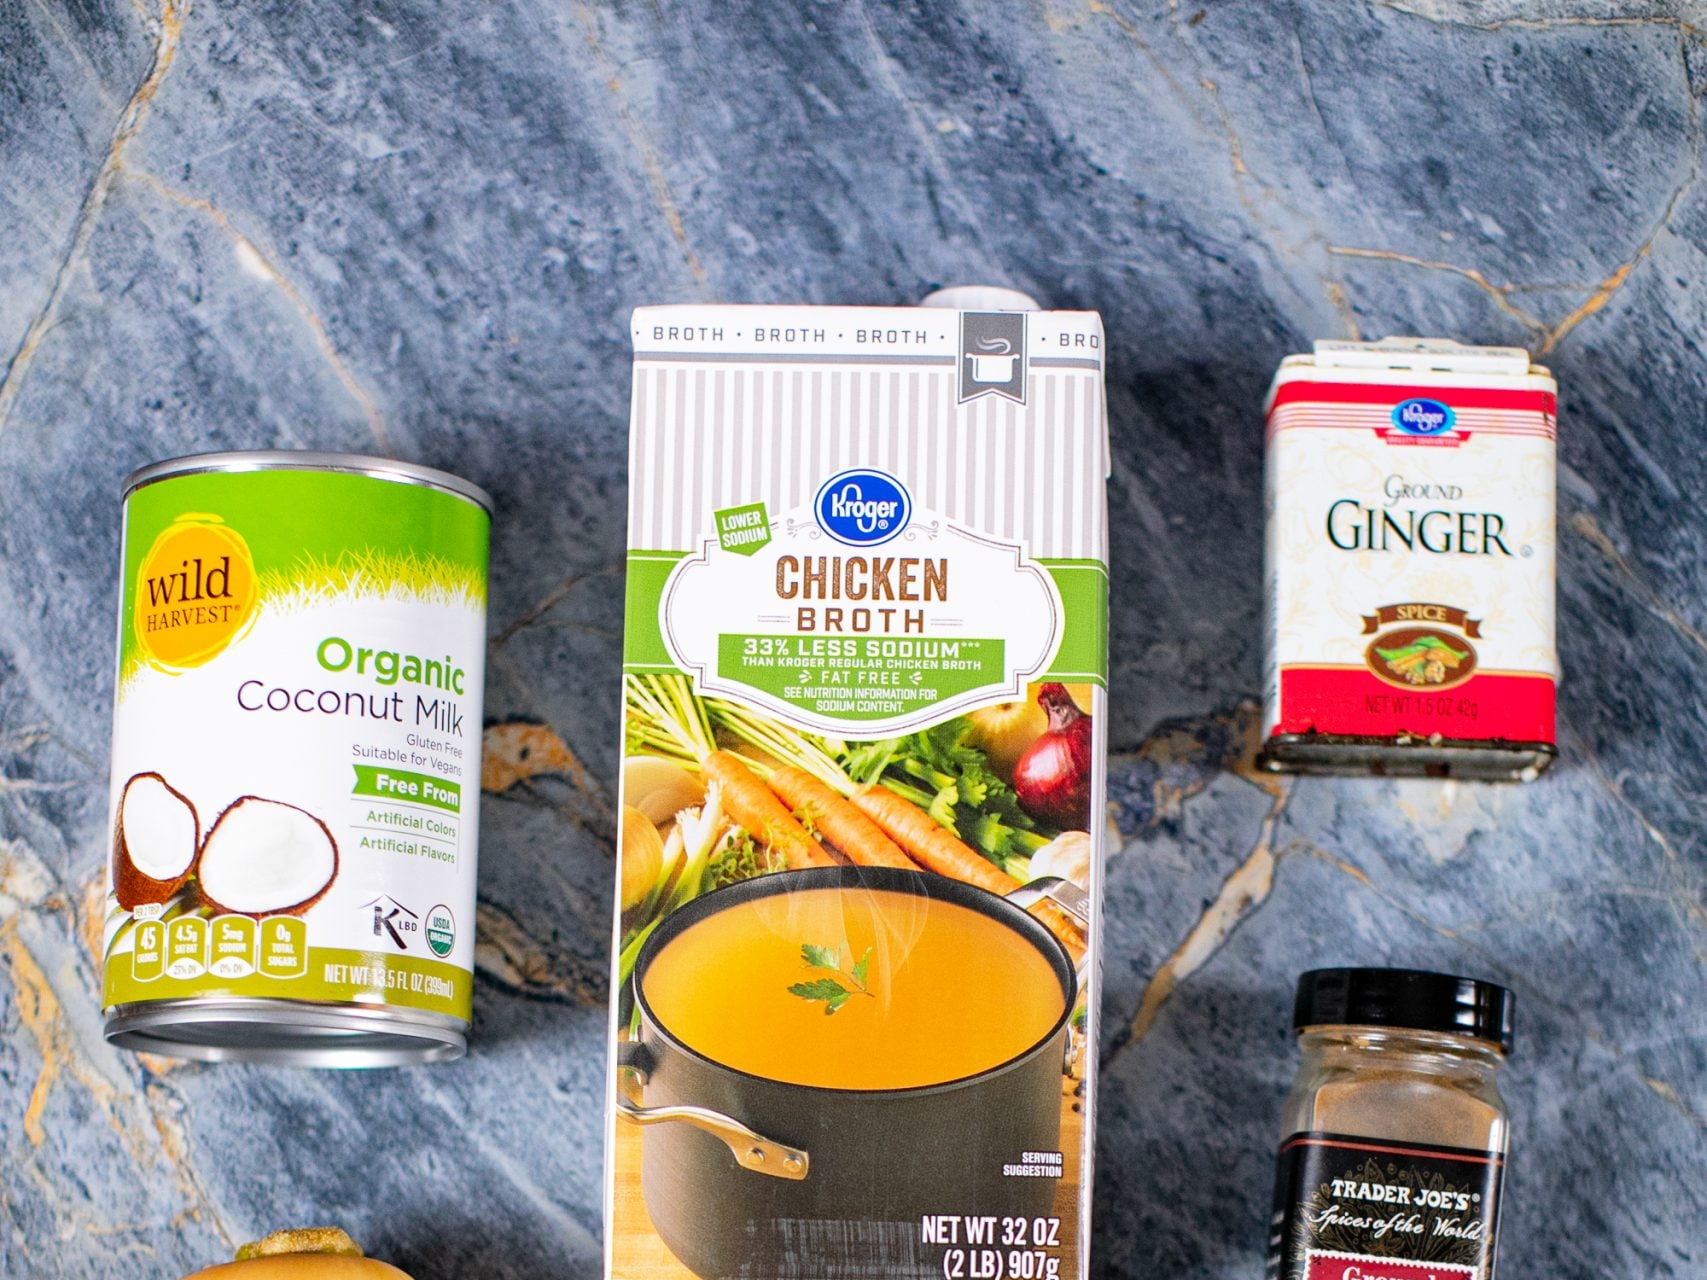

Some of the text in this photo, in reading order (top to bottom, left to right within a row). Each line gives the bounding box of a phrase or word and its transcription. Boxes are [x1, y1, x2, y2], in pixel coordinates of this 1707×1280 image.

[653, 326, 724, 342] BROTH
[754, 327, 826, 343] BROTH
[856, 329, 928, 344] BROTH
[832, 483, 898, 533] Kroger
[721, 511, 763, 531] LOWER
[1327, 499, 1514, 557] GINGER
[722, 527, 768, 548] SODIUM
[147, 556, 233, 607] wild
[775, 555, 948, 602] CHICKEN
[146, 604, 234, 633] HARVEST
[797, 607, 925, 633] BROTH
[1396, 604, 1447, 621] SPICE
[744, 638, 790, 656] 33%
[798, 639, 857, 657] LESS
[317, 637, 465, 695] Organic
[742, 657, 981, 671] THAN KROGER REGULAR CHICKEN BROTH
[821, 671, 900, 685] FAT FREE
[784, 687, 938, 700] SEE NUTRITION INFORMATION FOR
[237, 680, 464, 737] Coconut Milk
[816, 701, 855, 712] SODIUM
[1365, 696, 1389, 714] NET
[1392, 696, 1411, 714] WT
[1438, 697, 1453, 716] OZ
[1457, 698, 1478, 720] 42g
[406, 733, 462, 759] Gluten Free
[352, 744, 462, 776] Suitable for Vegans
[376, 773, 459, 807] Free From
[366, 810, 456, 838] Artificial Colors
[360, 836, 455, 864] Artificial Flavors
[175, 924, 198, 942] 4.5g
[222, 923, 244, 941] 5mg
[275, 924, 291, 942] 0g
[398, 920, 418, 932] LBD
[433, 916, 450, 930] USDA
[140, 926, 156, 950] 45
[186, 944, 198, 953] FAT
[218, 943, 246, 953] SODIUM
[272, 943, 294, 954] TOTAL
[268, 956, 297, 967] SUGARS
[324, 963, 348, 984] NET
[350, 966, 369, 985] WT
[397, 971, 408, 990] FL
[411, 973, 423, 992] OZ
[1022, 1152, 1063, 1164] SERVING
[1003, 1165, 1063, 1177] SUGGESTION
[1330, 1179, 1470, 1211] TRADER JOE'S
[922, 1215, 1060, 1247] NET WT 32 OZ
[1309, 1204, 1487, 1240] Spices of the World
[943, 1249, 965, 1280] (2
[969, 1249, 1004, 1280] LB)
